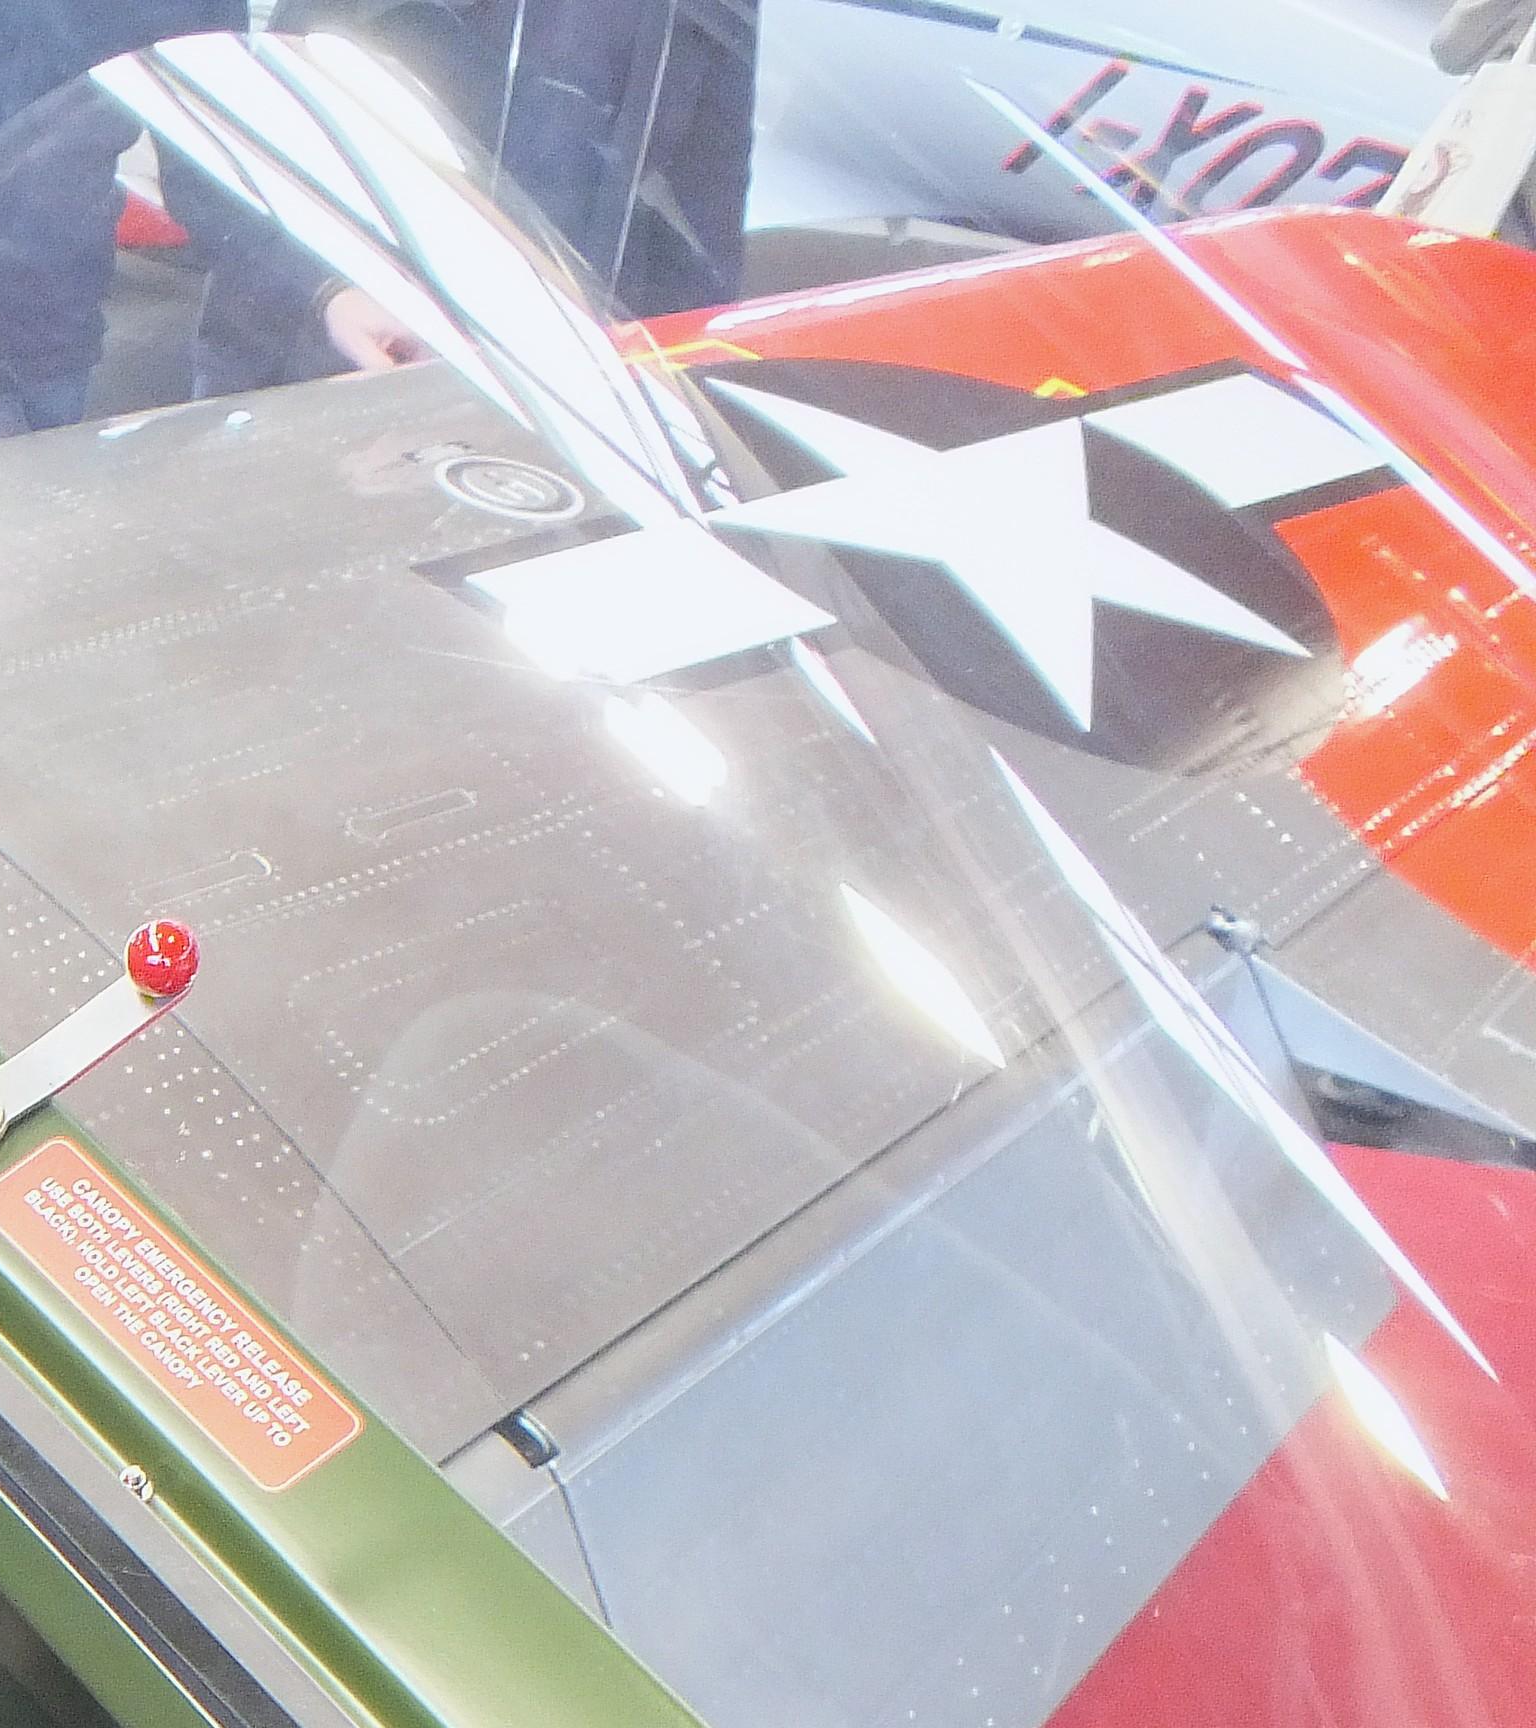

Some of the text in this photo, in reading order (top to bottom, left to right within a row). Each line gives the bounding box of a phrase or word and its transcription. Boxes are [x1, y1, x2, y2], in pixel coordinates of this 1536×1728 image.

[40, 1177, 311, 1434] USE BOTH LEVERS (RIGHT RED AND LEFT
[72, 1179, 312, 1407] CANOPY EMERGENCY RELEASE
[74, 1266, 204, 1389] OPEN THE CANOPY
[75, 1239, 119, 1280] HOLD
[113, 1277, 156, 1313] LEFT
[147, 1310, 203, 1362] BLACK
[195, 1356, 248, 1406] LEVER
[242, 1401, 270, 1424] UP
[265, 1422, 292, 1447] TO
